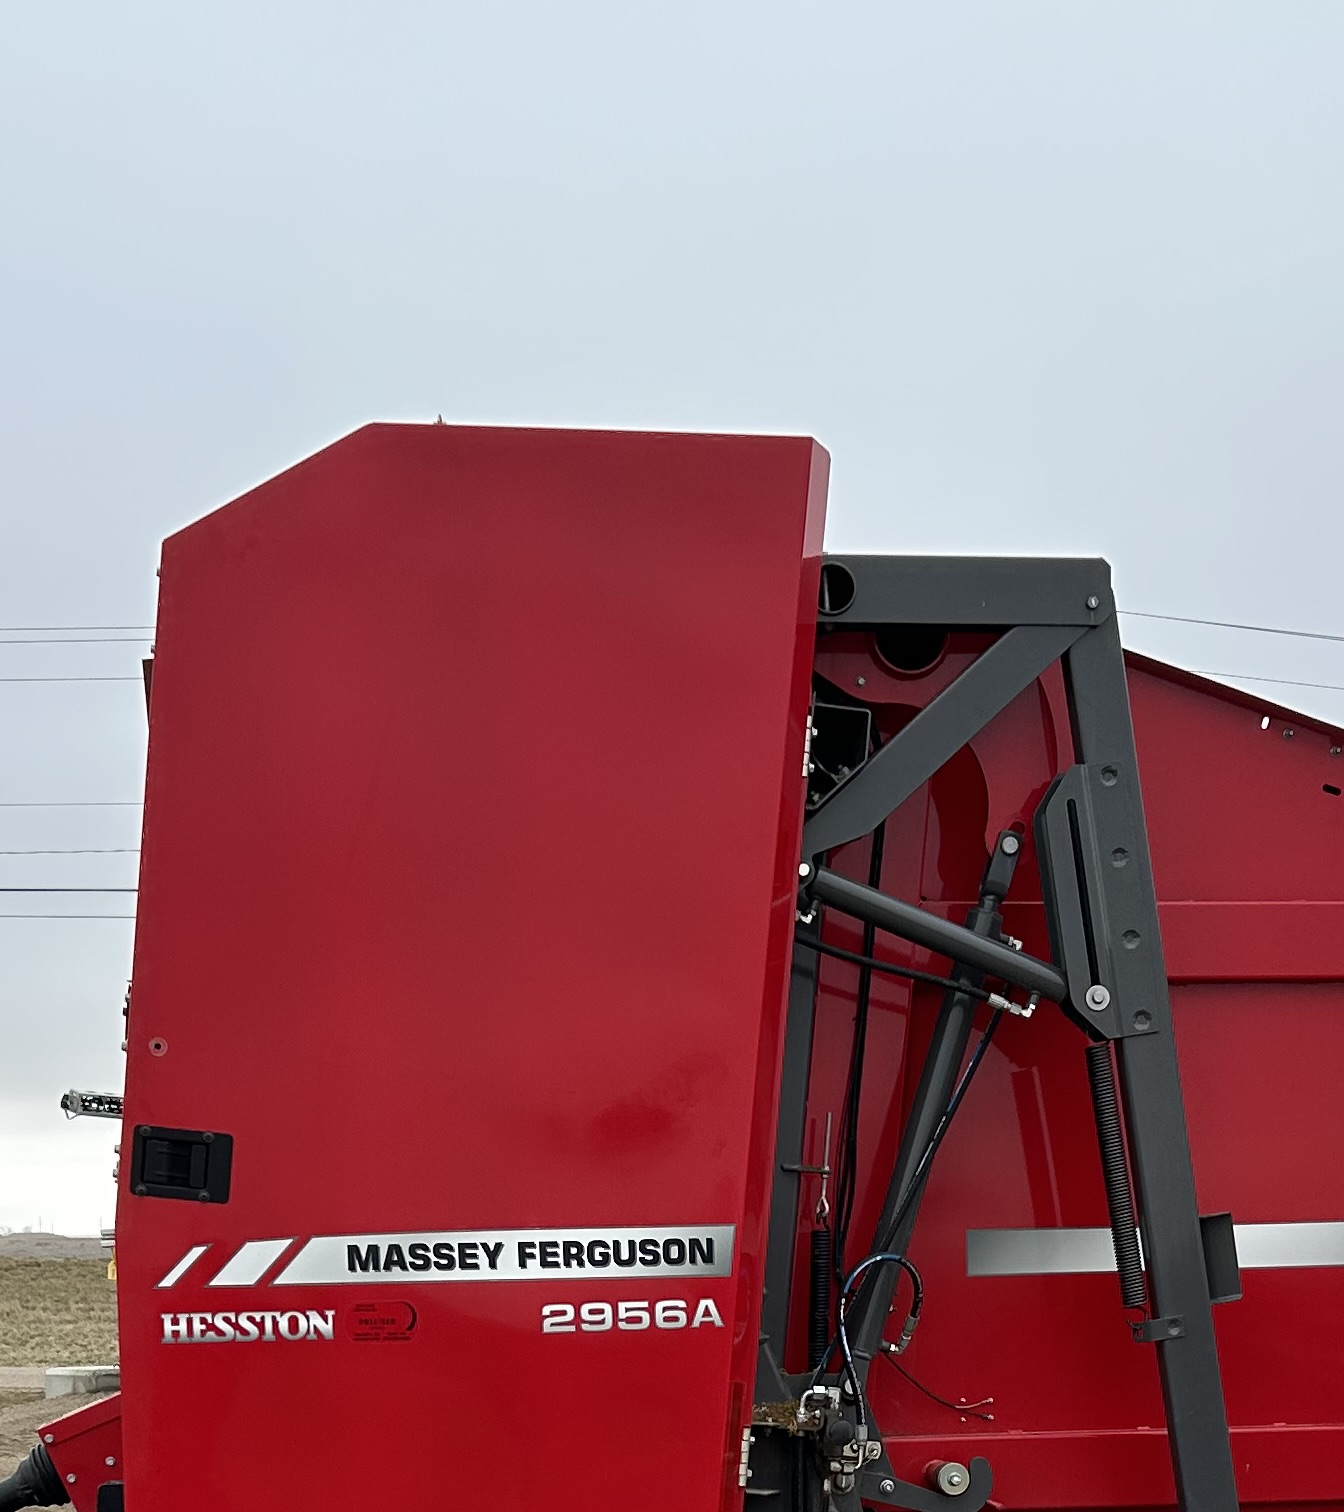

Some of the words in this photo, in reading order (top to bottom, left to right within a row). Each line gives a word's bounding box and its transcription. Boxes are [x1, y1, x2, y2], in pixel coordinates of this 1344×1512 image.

[346, 1241, 504, 1273] MASSEY
[517, 1237, 715, 1270] FERGUSON
[160, 1309, 336, 1345] HESSTON
[541, 1298, 725, 1334] 2956A
